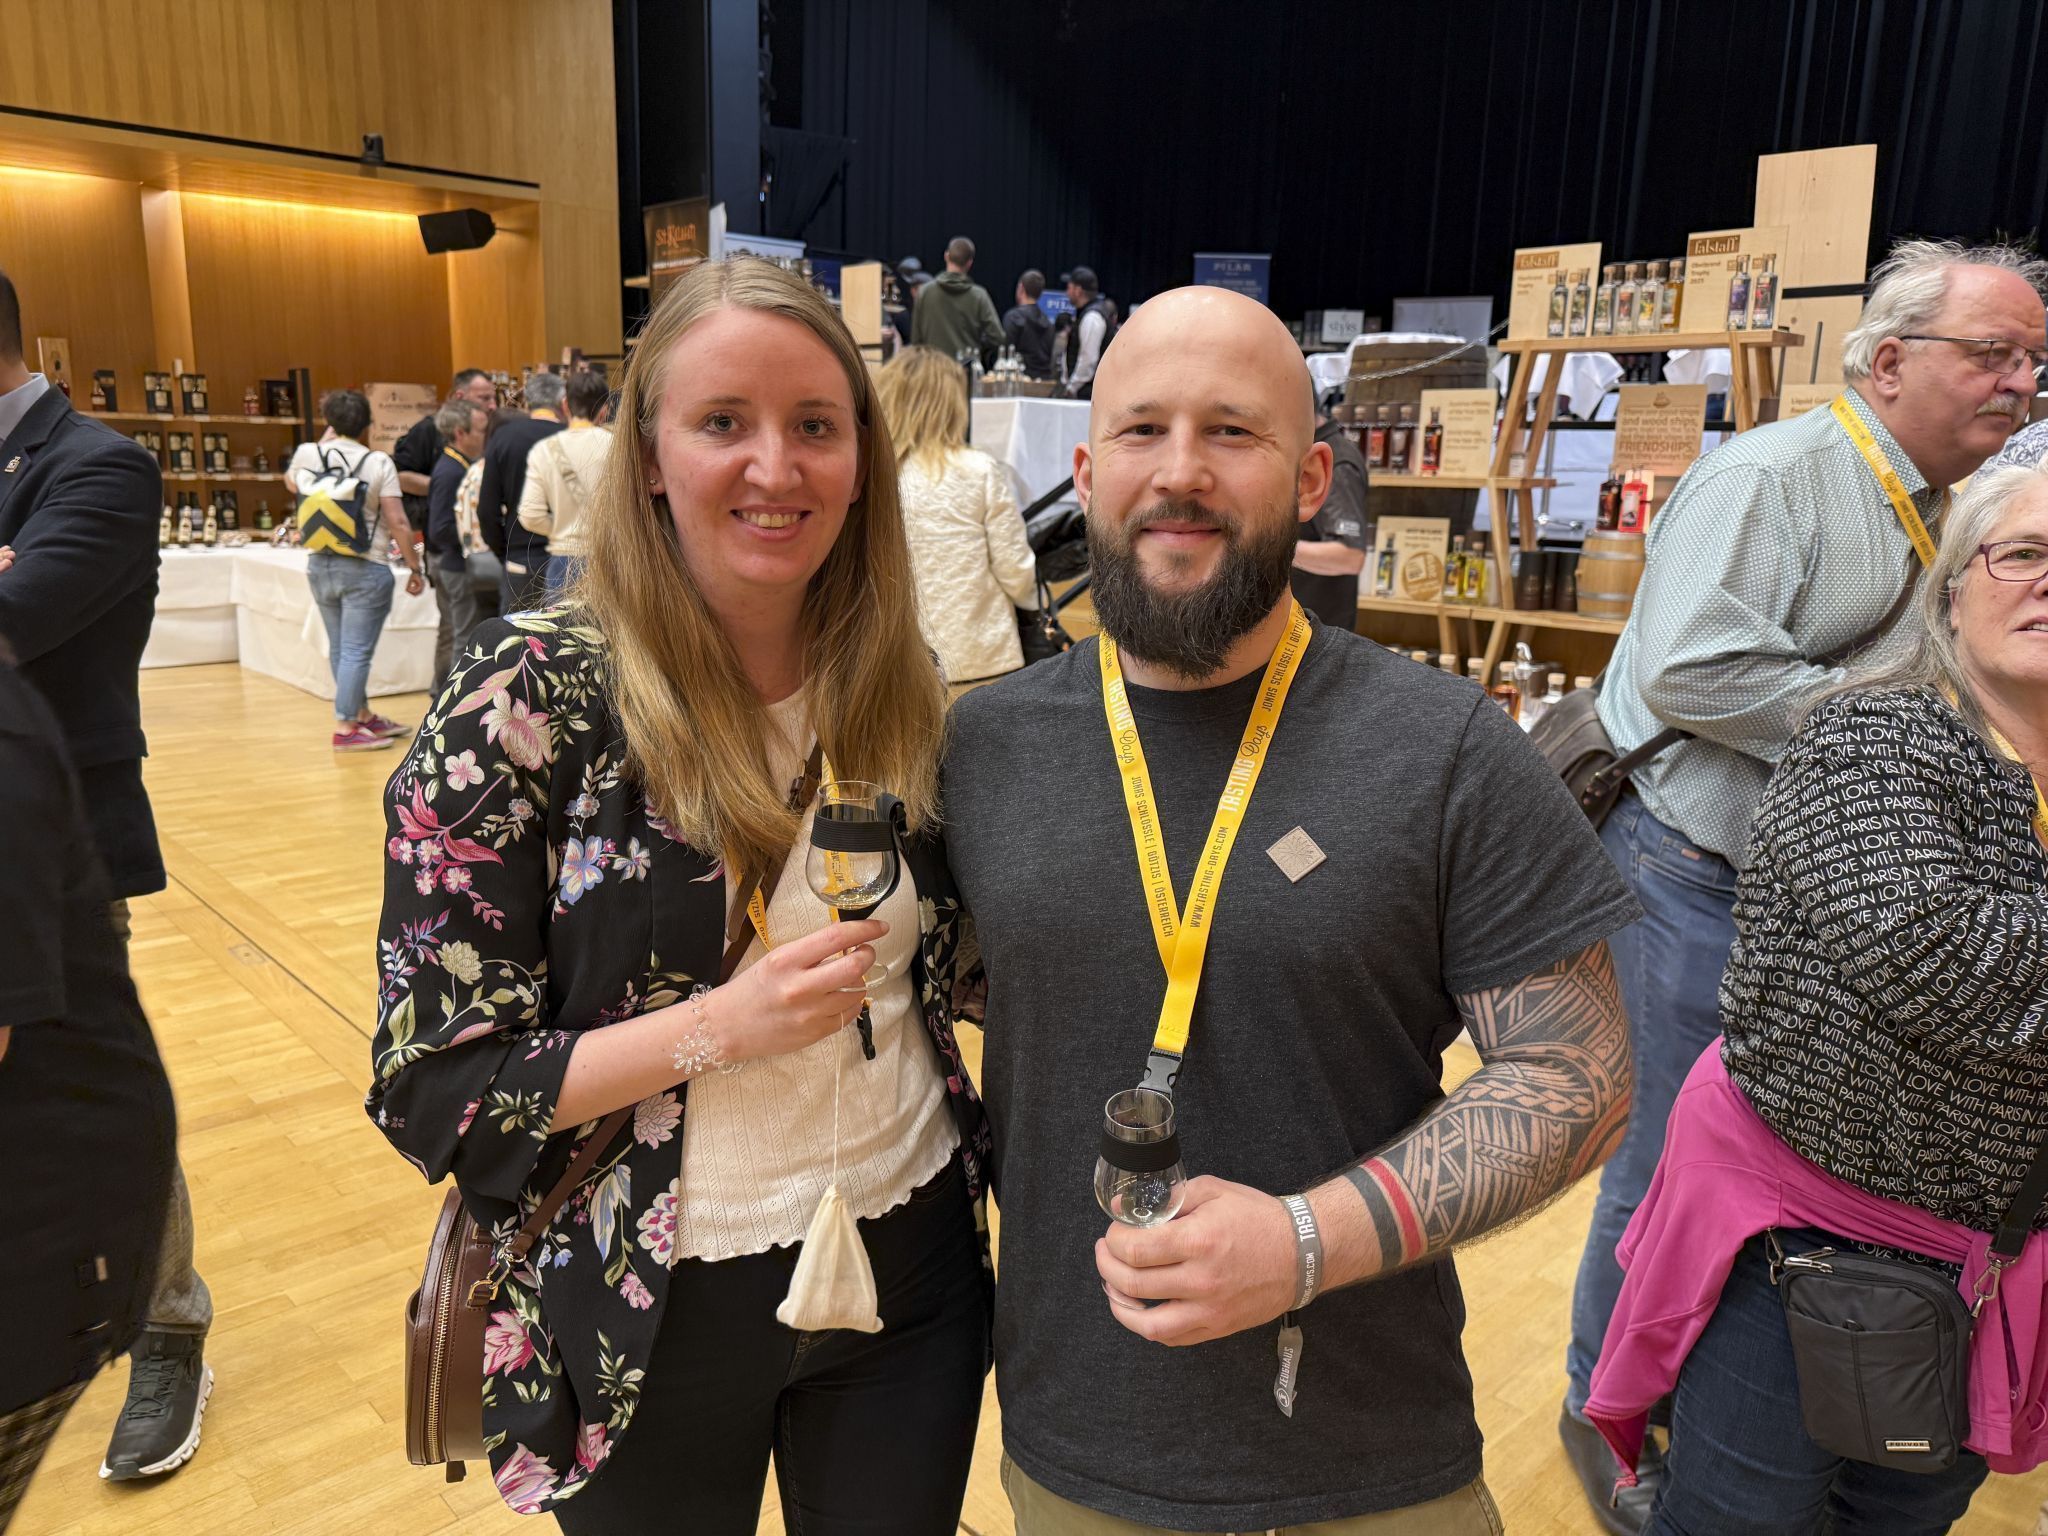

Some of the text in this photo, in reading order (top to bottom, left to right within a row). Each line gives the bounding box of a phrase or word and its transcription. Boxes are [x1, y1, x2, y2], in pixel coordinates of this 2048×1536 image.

[1694, 237, 1736, 255] falstaff
[1108, 675, 1134, 731] TASTING
[1822, 704, 1853, 720] LOVE
[1118, 730, 1137, 763] Days
[1218, 757, 1256, 812] TASTING
[1240, 725, 1271, 757] Days
[1262, 686, 1278, 712] JONAS
[1796, 717, 1848, 750] LOVE WITH
[1860, 743, 1900, 759] WITH
[1864, 727, 1903, 741] LOVE
[1131, 776, 1145, 798] JONAS
[1800, 781, 1826, 802] WITH
[1801, 763, 1825, 787] LOVE
[1777, 812, 1800, 831] WITH
[1841, 780, 1882, 800] LOVE
[1883, 777, 1927, 792] WITH
[1810, 809, 1841, 832] LOVE
[1841, 798, 1881, 818] WITH
[1786, 839, 1812, 860] LOVE
[1811, 826, 1841, 848] WITH
[1903, 812, 1943, 829] LOVE
[1788, 856, 1814, 876] WITH
[1860, 831, 1902, 850] LOVE
[1903, 830, 1945, 847] WITH
[1190, 826, 1229, 929] WWW.TASTING-DAYS.COM
[1826, 849, 1903, 880] LOVE WITH
[1975, 864, 2007, 885] LOVE
[1804, 886, 1829, 908] LOVE
[1827, 876, 1860, 897] WITH
[1923, 862, 1962, 878] LOVE
[1878, 880, 1919, 902] LOVE
[1154, 886, 1175, 938] ÖSTERREICH
[1844, 909, 1872, 932] LOVE
[1847, 928, 1875, 950] WITH
[1998, 939, 2021, 976] LOVE
[1804, 958, 1839, 980] LOVE
[1871, 940, 1933, 987] LOVE WITH
[1930, 924, 1987, 997] LOVE WITH
[1876, 981, 1912, 1006] WITH
[1943, 975, 1981, 1010] WITH
[1982, 950, 2038, 1023] LOVE WITH
[1768, 971, 1795, 991] LOVE
[1796, 977, 1826, 998] WITH
[1877, 1012, 1915, 1045] LOVE
[1992, 1000, 2024, 1034] WITH
[1820, 1022, 1852, 1048] WITH
[1906, 1072, 1947, 1097] LOVE
[1950, 1089, 1987, 1114] WITH
[1828, 1008, 1864, 1036] LOVE
[1866, 1026, 1903, 1058] WITH
[1961, 1077, 2001, 1098] LOVE
[2003, 1086, 2037, 1106] WITH
[1765, 1070, 1792, 1095] WITH
[1844, 1105, 1884, 1127] LOVE
[1772, 1058, 1802, 1081] LOVE
[1803, 1066, 1838, 1094] WITH
[1925, 1130, 1960, 1153] WITH
[1812, 1056, 1847, 1082] LOVE
[1850, 1072, 1887, 1099] WITH
[1934, 1118, 1976, 1145] LOVE
[1978, 1136, 2014, 1159] WITH
[1859, 1060, 1895, 1090] LOVE
[1896, 1084, 1932, 1109] WITH
[1990, 1121, 2025, 1141] LOVE
[1731, 1069, 1755, 1094] WITH
[1800, 1102, 1835, 1125] LOVE
[1836, 1117, 1874, 1137] WITH
[1922, 1164, 1951, 1182] LOVE
[1757, 1103, 1789, 1124] LOVE
[1792, 1115, 1827, 1138] WITH
[1913, 1177, 1950, 1199] WITH
[1796, 1143, 1828, 1169] LOVE
[1830, 1158, 1867, 1184] WITH
[1837, 1148, 1874, 1172] LOVE
